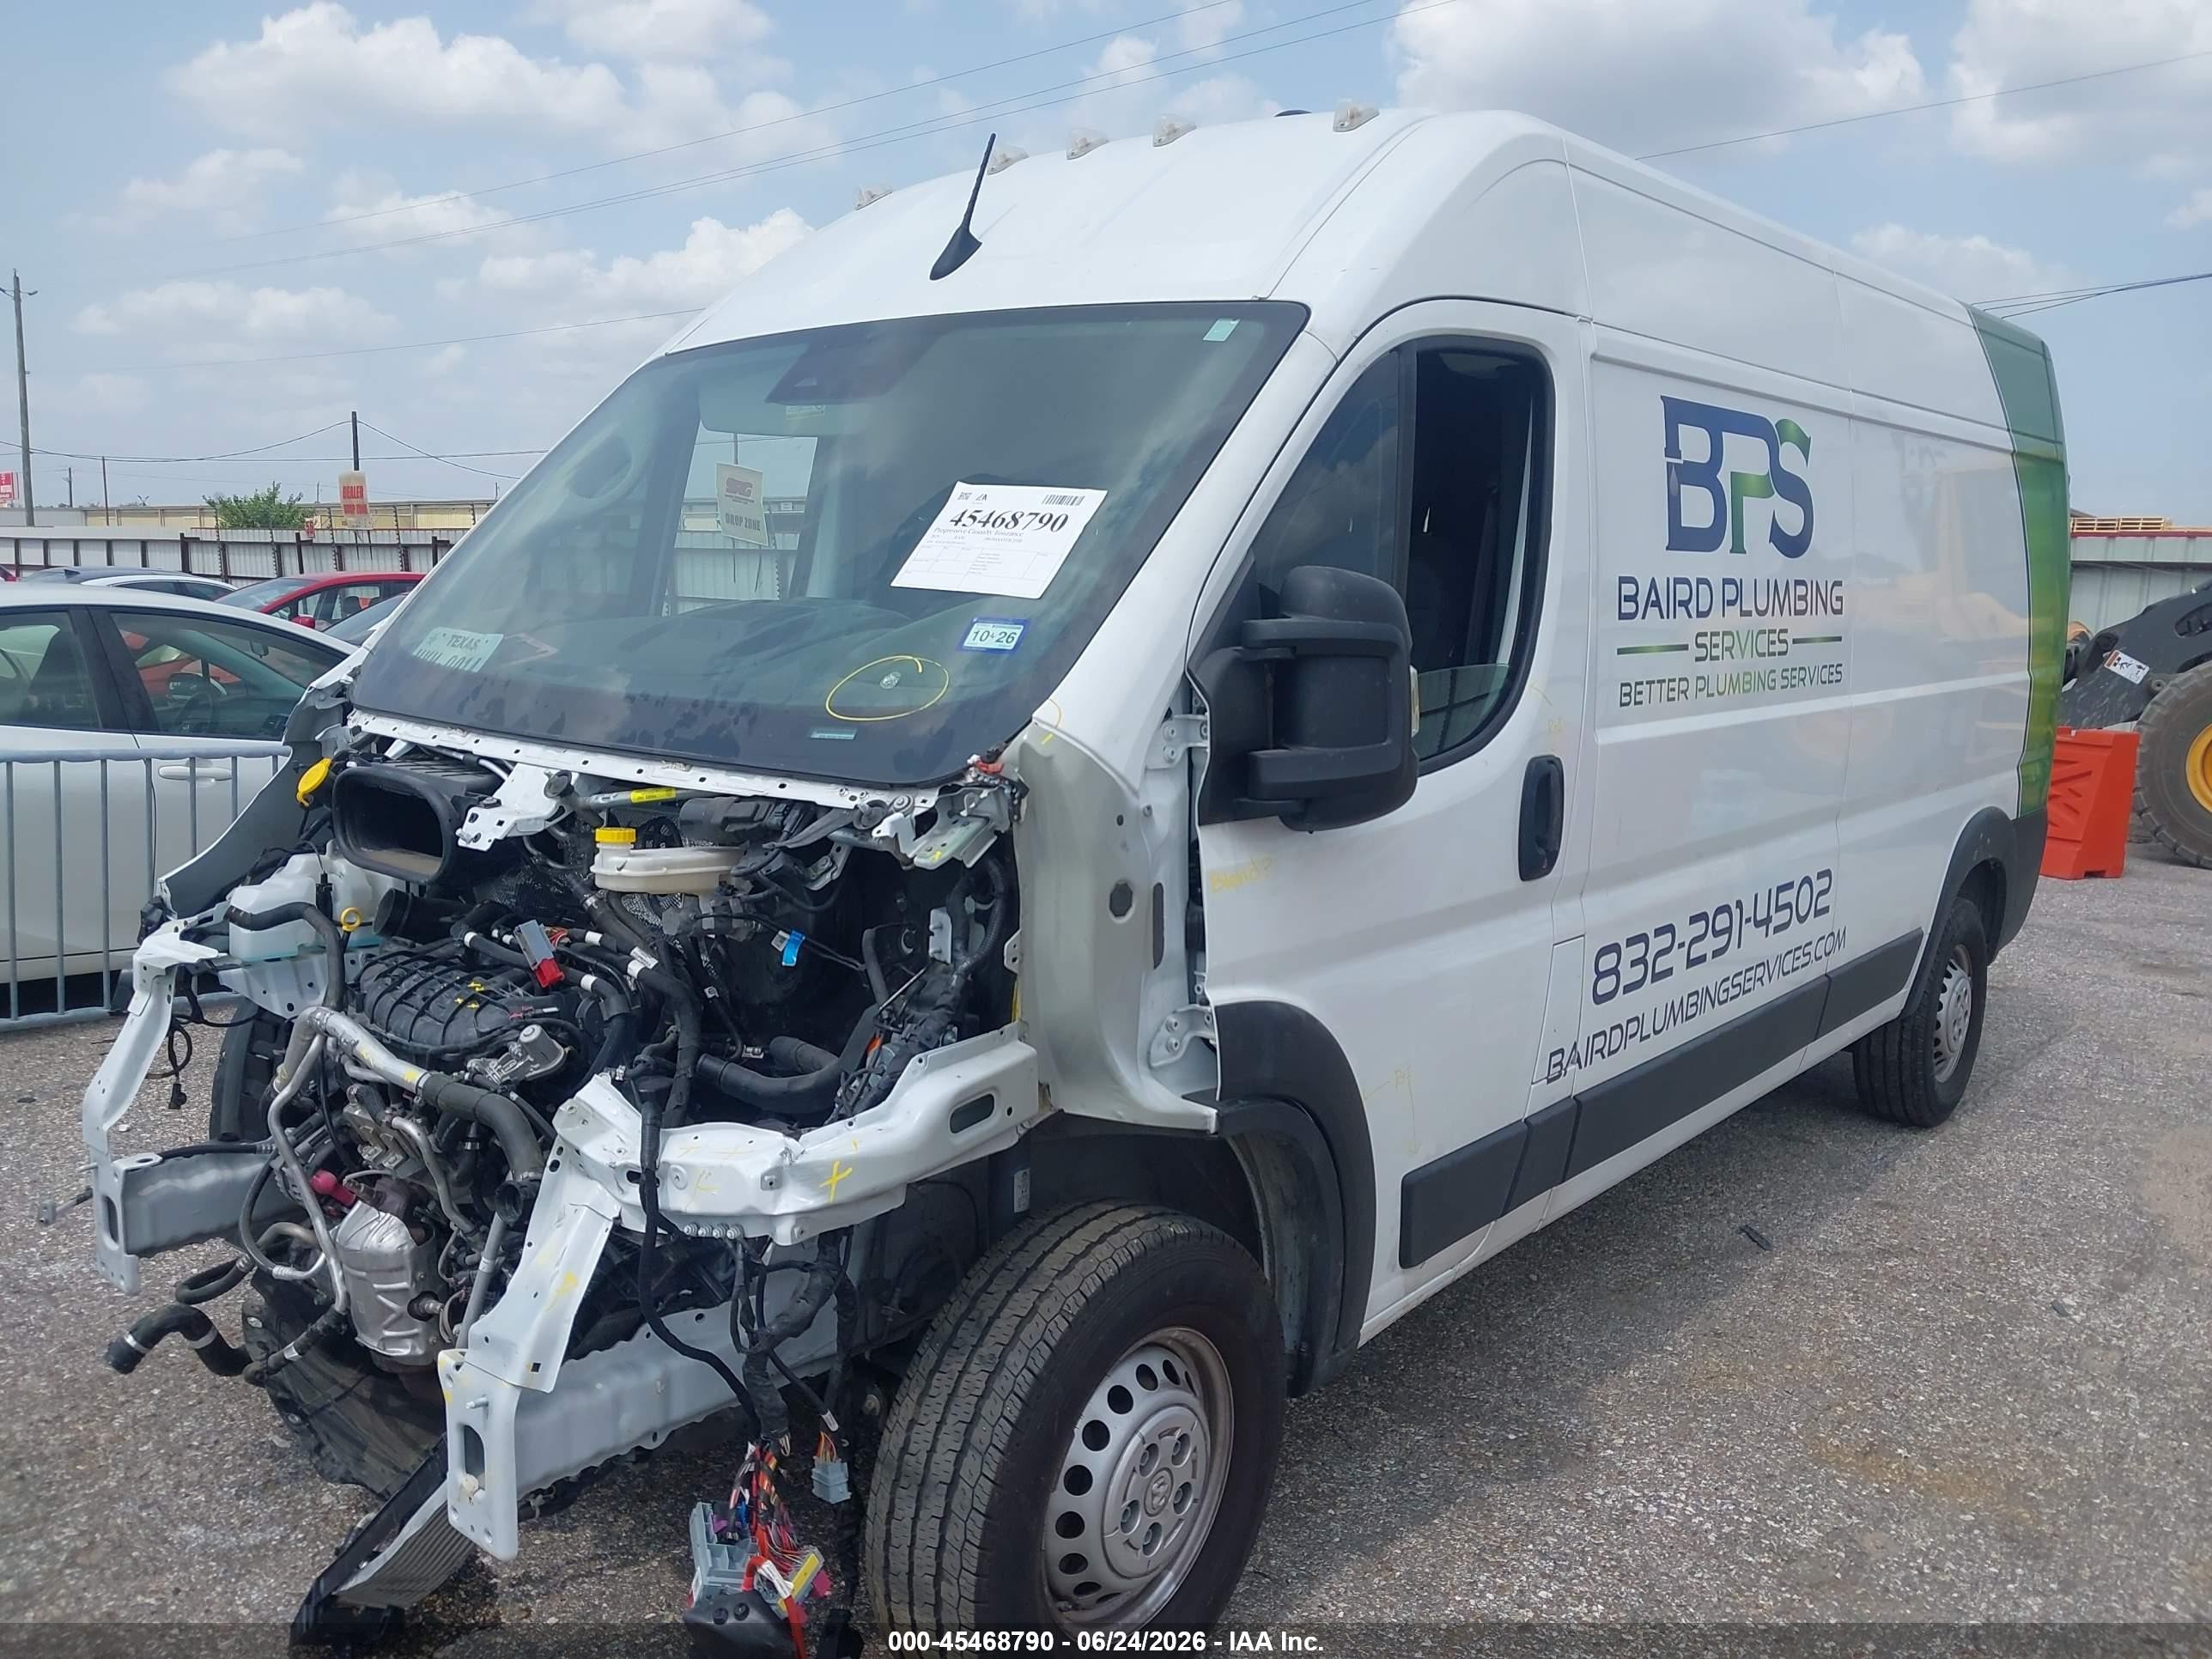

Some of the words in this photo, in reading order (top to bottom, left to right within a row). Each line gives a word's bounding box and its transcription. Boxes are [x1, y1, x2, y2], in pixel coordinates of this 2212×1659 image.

[1660, 394, 1815, 559] BPS
[726, 514, 744, 527] DROP
[949, 508, 1069, 533] 45468790
[1618, 575, 1714, 620] BAIRD
[1722, 579, 1844, 618] PLUMBING
[447, 635, 482, 650] TEXAS
[972, 629, 991, 642] 10
[995, 631, 1018, 644] 26
[1694, 628, 1790, 662] SERVICES
[1619, 676, 1690, 708] BETTER
[1694, 668, 1777, 699] PLUMBING
[1780, 663, 1844, 690] SERVICES
[1591, 867, 1833, 1006] 832-291-4502
[1546, 926, 1848, 1085] BAIRDPLUMBINGSERVICES.COM
